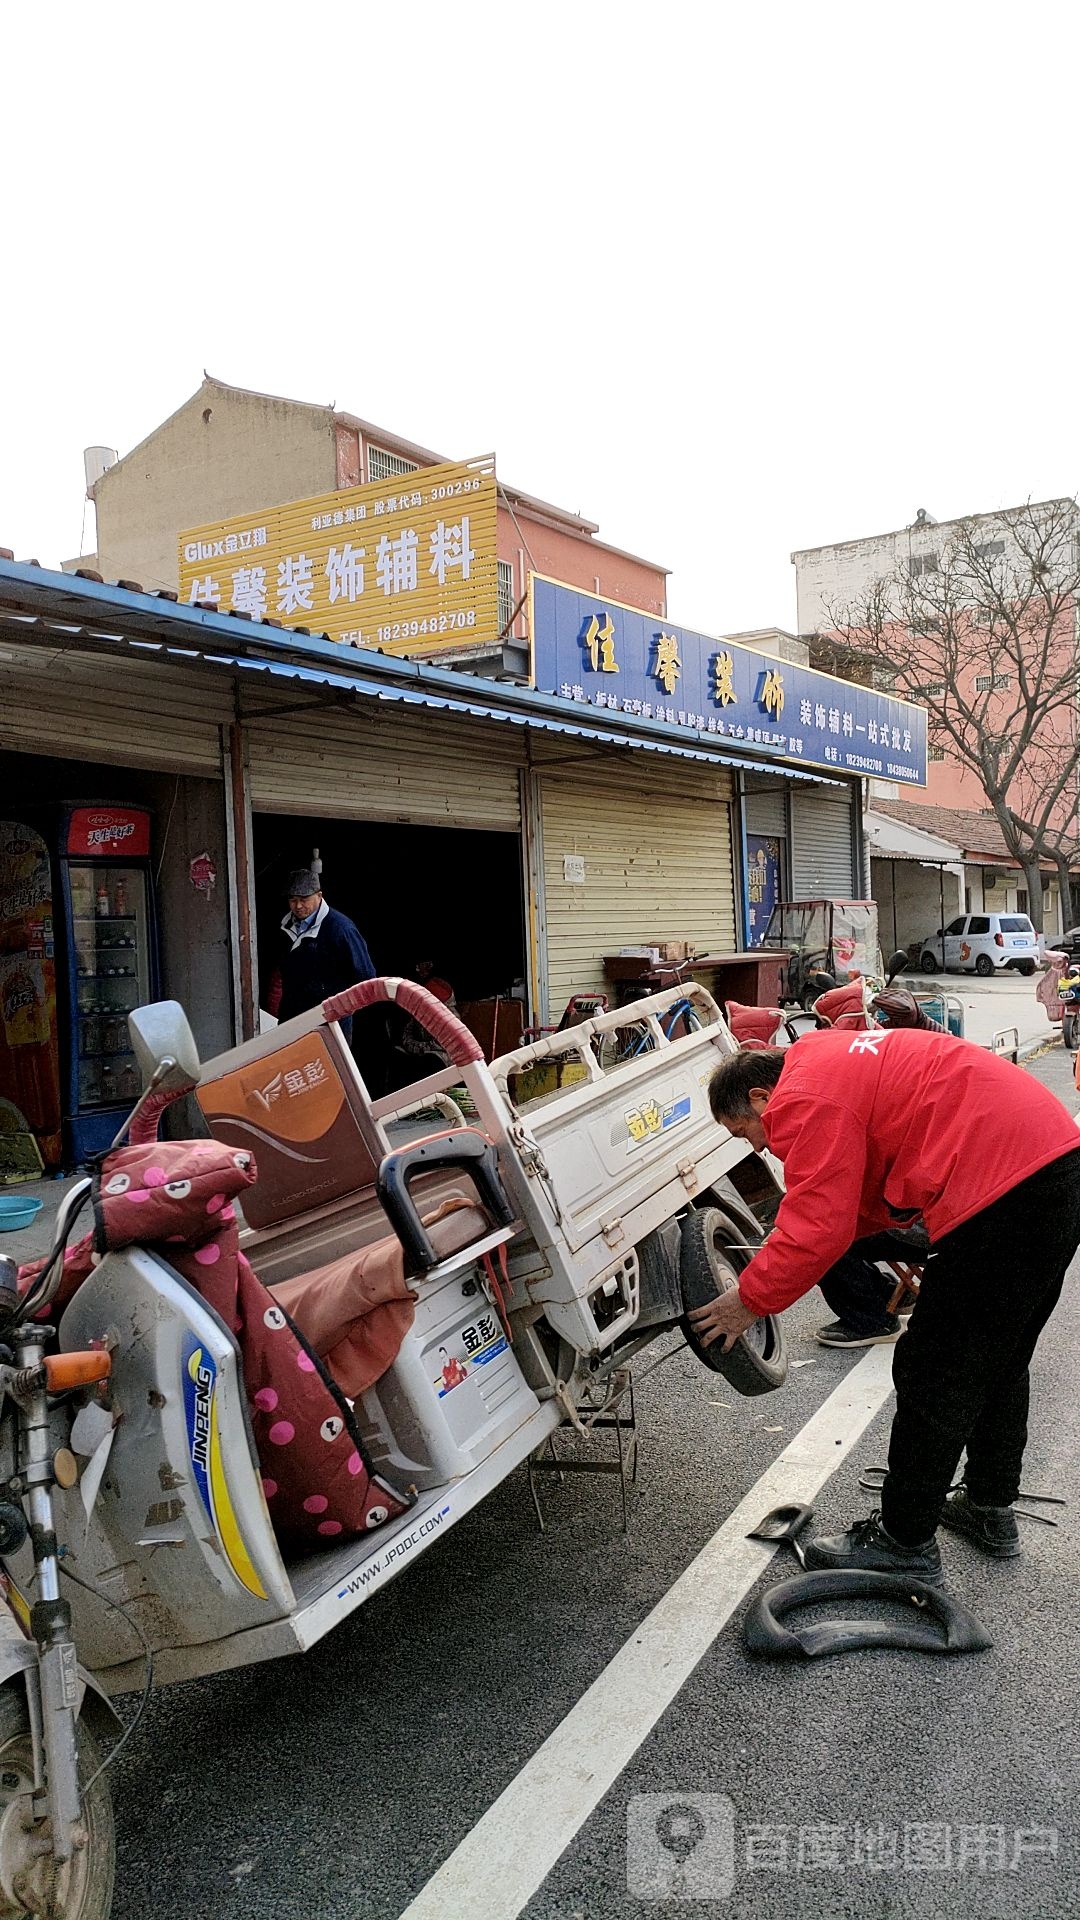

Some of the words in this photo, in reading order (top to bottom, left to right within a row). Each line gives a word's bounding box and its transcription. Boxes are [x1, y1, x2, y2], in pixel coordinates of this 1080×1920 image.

[312, 505, 367, 531] 利亚德集团
[376, 610, 476, 642] 18239482708
[586, 612, 785, 722] 佳馨装饰
[800, 698, 912, 753] 装饰辅料一站式批发
[284, 1058, 325, 1094] 金彭
[623, 1098, 661, 1142] 金彭
[461, 1314, 496, 1355] 金彭
[192, 1366, 212, 1472] JINPENG
